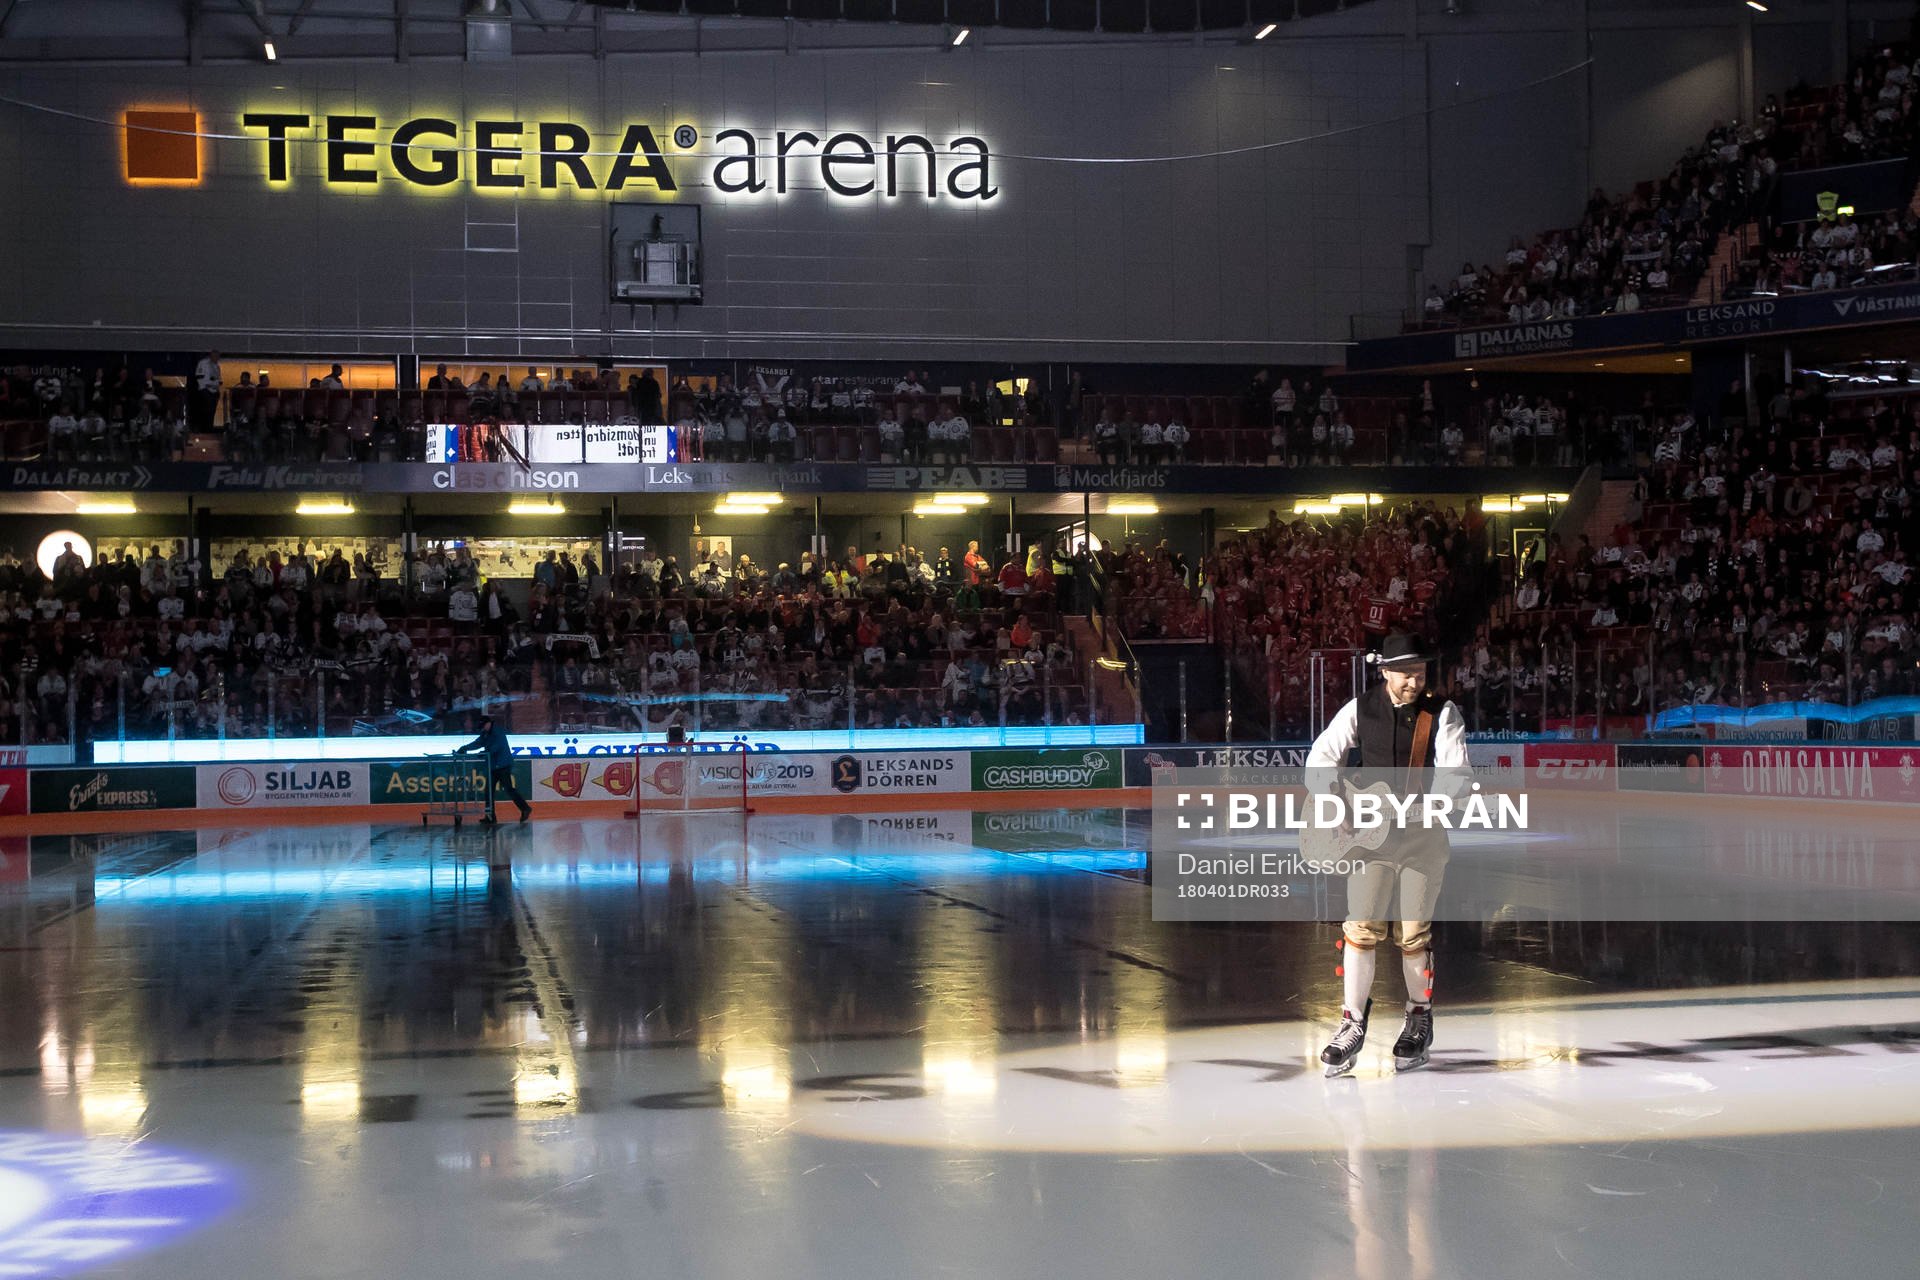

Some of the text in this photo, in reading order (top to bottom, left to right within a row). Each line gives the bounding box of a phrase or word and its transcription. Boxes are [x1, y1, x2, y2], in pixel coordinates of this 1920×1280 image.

[714, 128, 998, 207] arena
[1686, 302, 1776, 323] LEKSAND
[1480, 323, 1574, 346] DALARNAS
[1686, 318, 1774, 338] RESORT
[895, 467, 1005, 489] PEAB
[1074, 468, 1166, 489] Mockfjärds
[867, 758, 954, 773] LEKSANDS
[1195, 749, 1309, 768] LEKSAN
[1536, 758, 1608, 780] CCM
[265, 770, 352, 791] SILJAB
[701, 766, 755, 780] VISION
[777, 764, 815, 779] 2019
[867, 773, 937, 787] DÖRREN
[987, 769, 1092, 785] CASHBUDDY
[1742, 750, 1874, 798] ORMSALVA
[97, 790, 149, 805] EXPRESS
